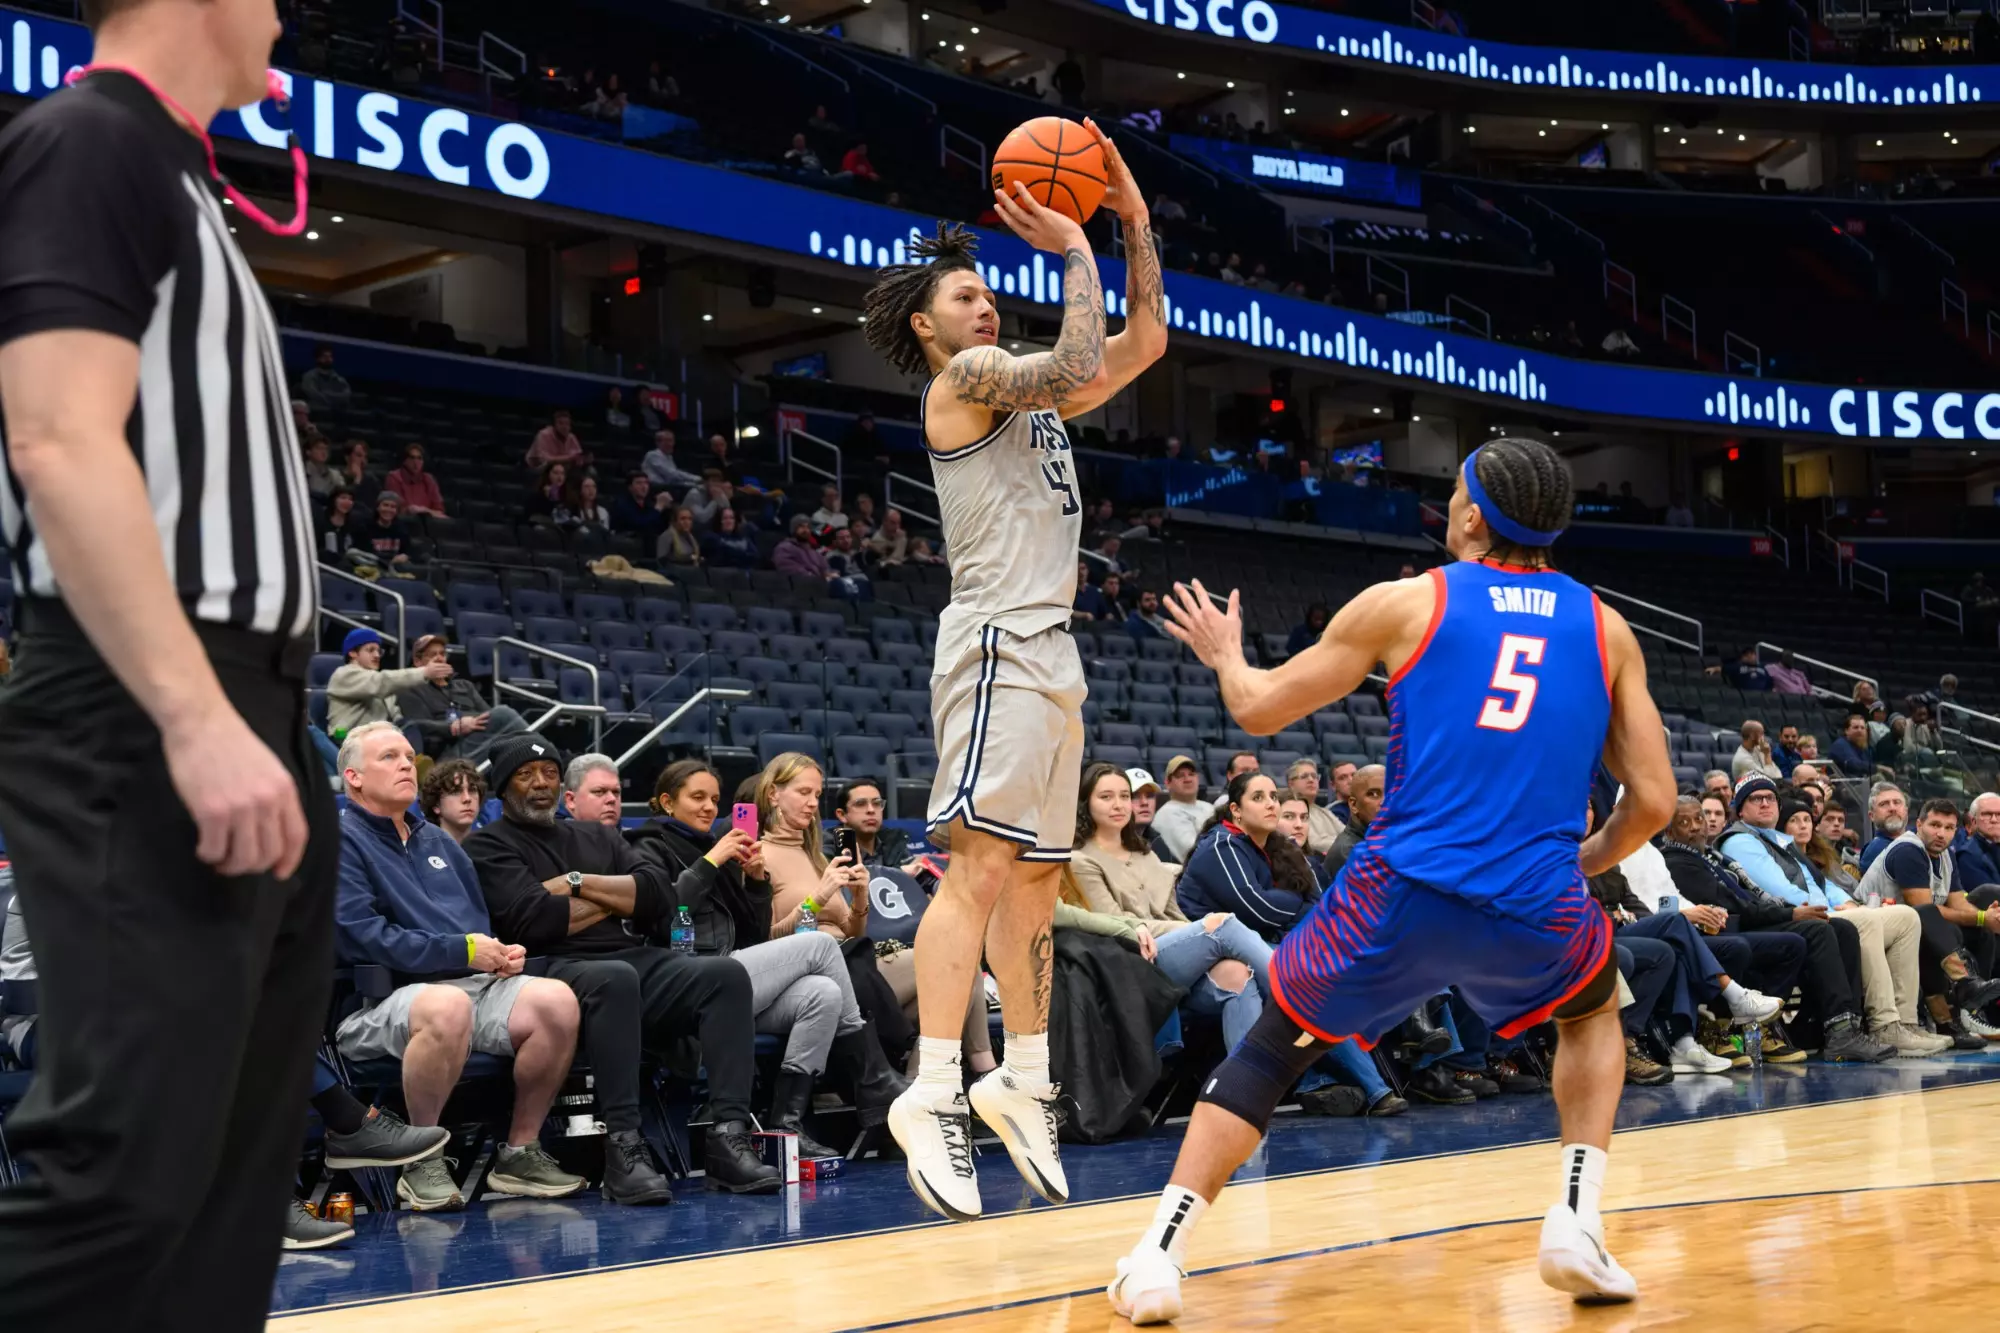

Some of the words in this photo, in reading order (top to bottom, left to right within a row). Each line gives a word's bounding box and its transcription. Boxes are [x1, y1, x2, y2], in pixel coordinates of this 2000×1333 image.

[239, 68, 550, 200] CISCO
[1488, 585, 1557, 618] SMITH
[1475, 631, 1548, 733] 5
[868, 876, 913, 919] G
